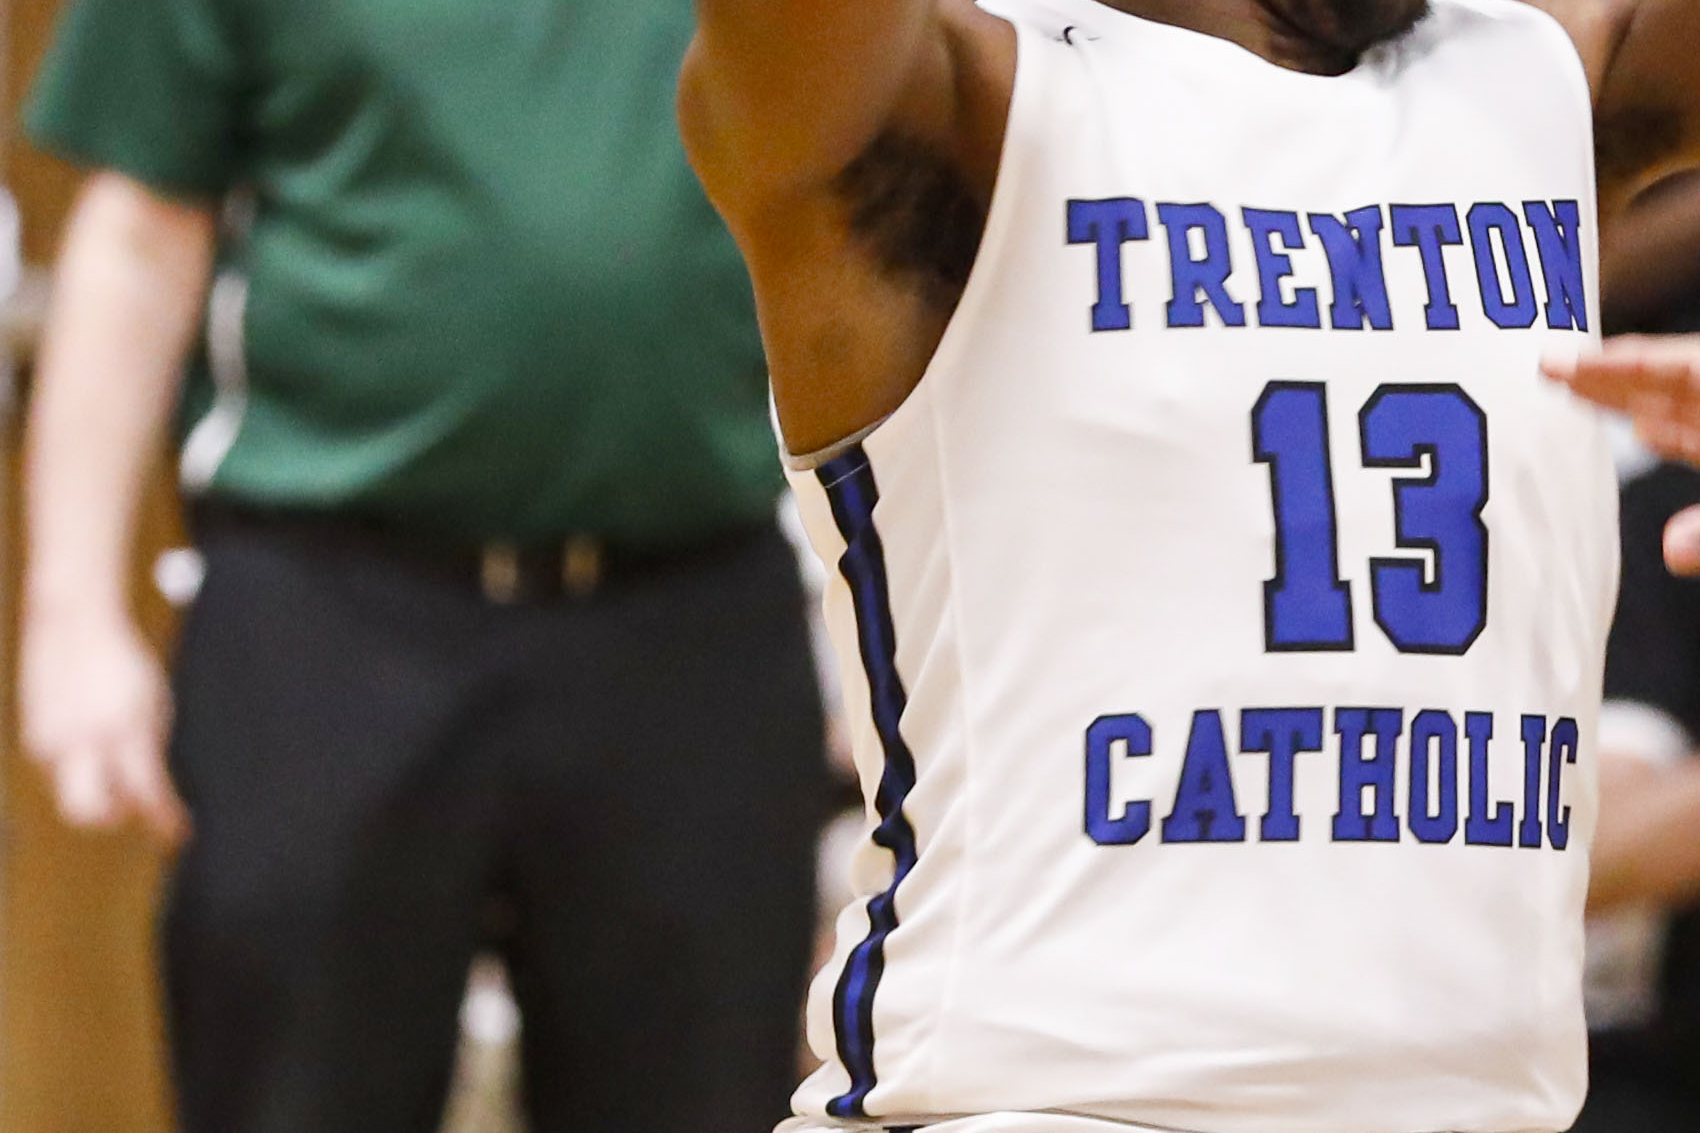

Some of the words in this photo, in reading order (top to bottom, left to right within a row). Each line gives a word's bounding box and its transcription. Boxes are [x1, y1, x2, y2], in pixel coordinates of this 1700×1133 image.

[1066, 197, 1589, 333] TRENTON
[1251, 379, 1488, 656] 13
[1084, 705, 1579, 851] CATHOLIC
